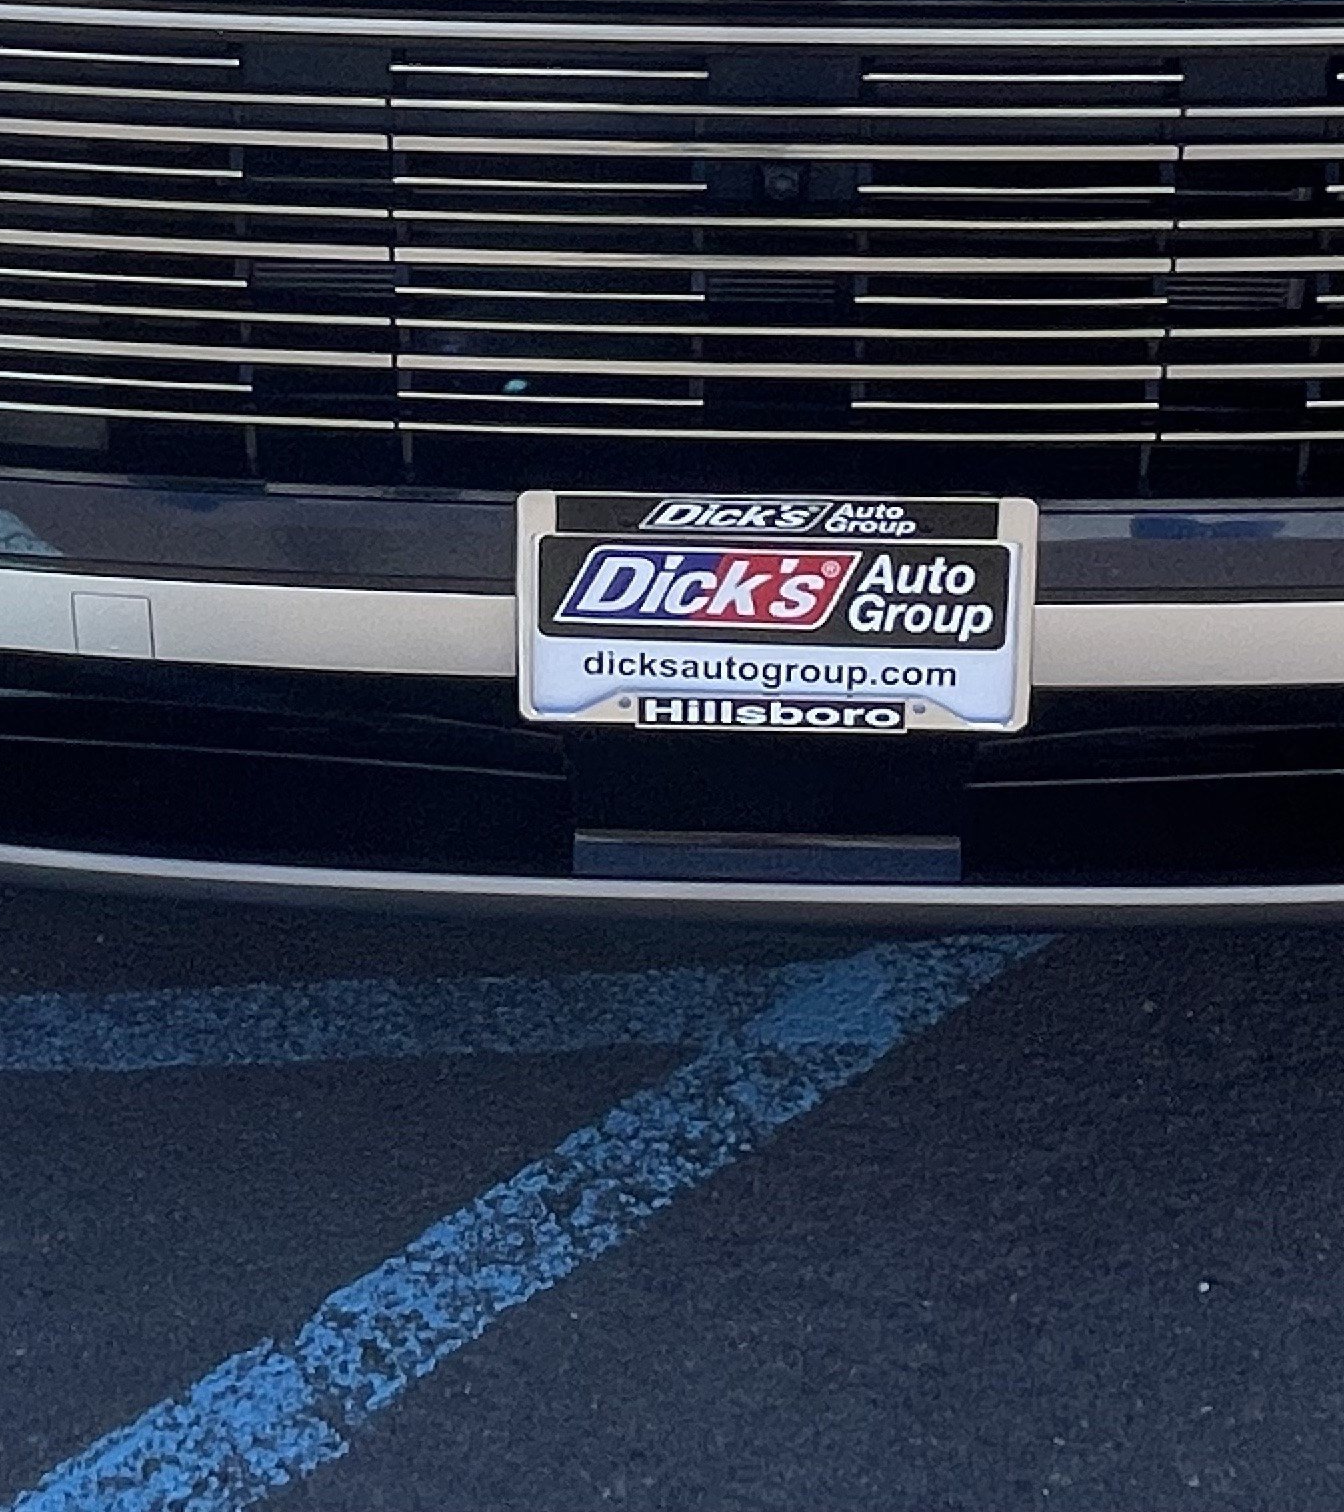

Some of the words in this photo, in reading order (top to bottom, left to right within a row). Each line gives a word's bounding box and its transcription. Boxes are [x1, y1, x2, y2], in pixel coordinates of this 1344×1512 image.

[824, 517, 917, 537] Group
[830, 502, 905, 521] Auto
[857, 554, 977, 595] Auto
[848, 594, 995, 642] Group
[583, 651, 958, 688] dicksautogroup.com
[644, 698, 901, 728] Hillsboro
